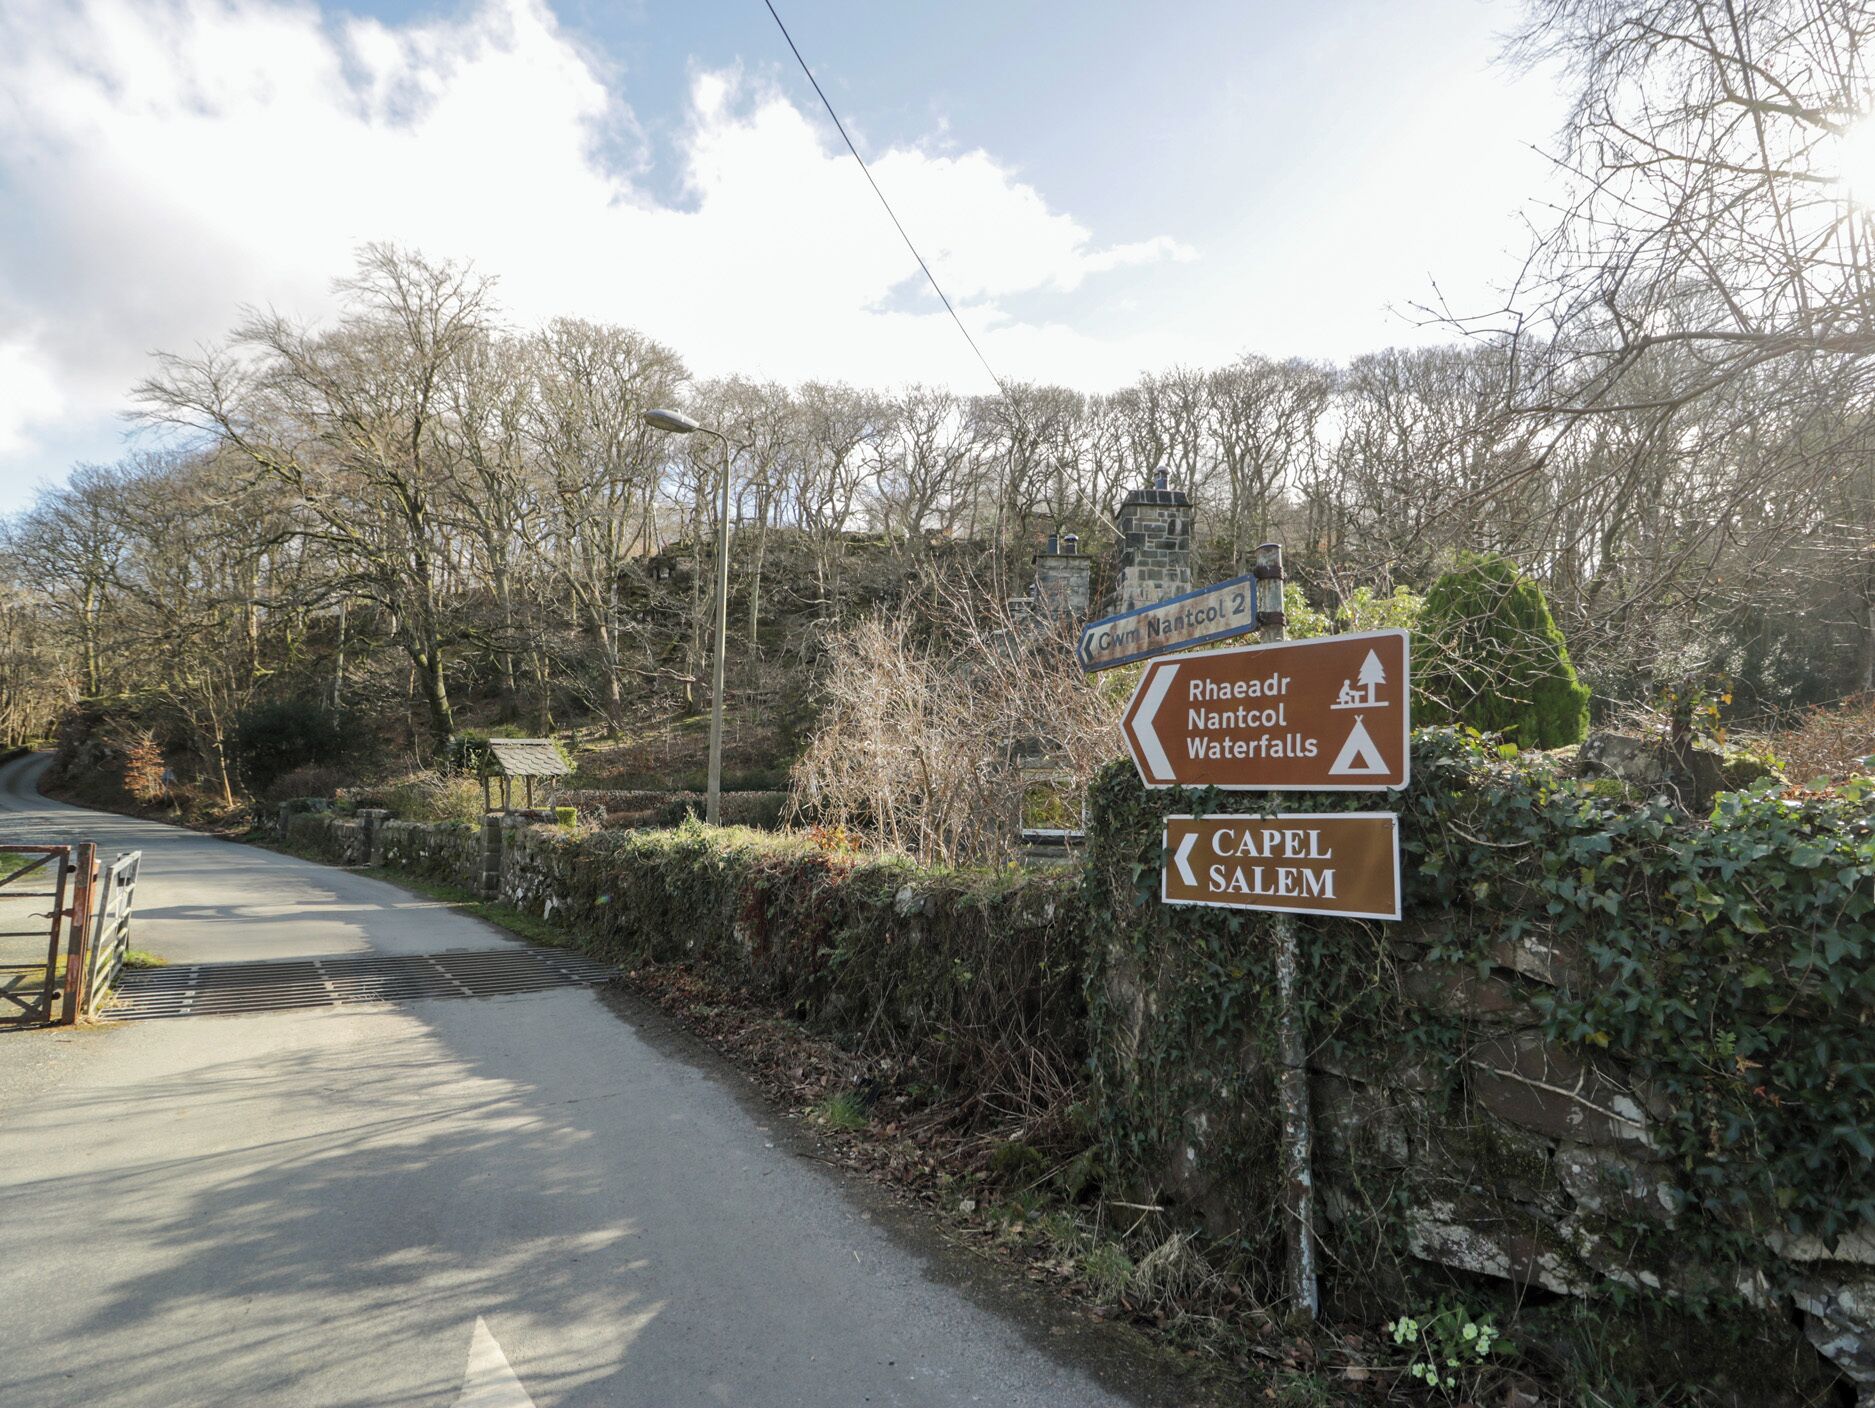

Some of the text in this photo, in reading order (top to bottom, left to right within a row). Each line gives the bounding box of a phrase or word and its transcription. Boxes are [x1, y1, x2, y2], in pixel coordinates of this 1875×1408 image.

[1099, 593, 1246, 652] Cwm Nantcol 2
[1189, 672, 1291, 701] Rhaeadr
[1188, 703, 1287, 730] Nantcol
[1186, 733, 1318, 760] Waterfalls
[1211, 828, 1332, 859] CAPEL
[1209, 864, 1336, 898] SALEM
